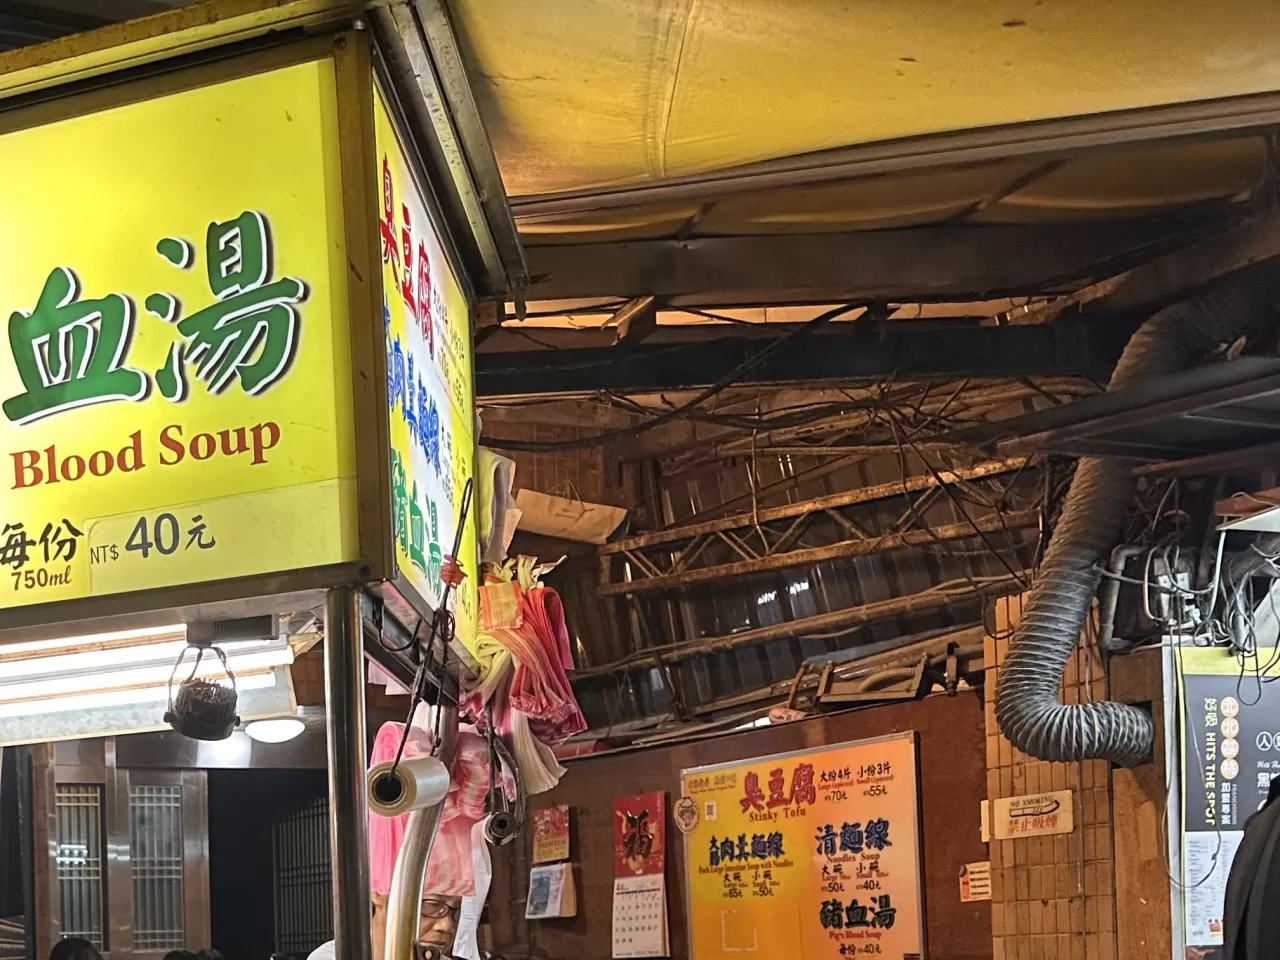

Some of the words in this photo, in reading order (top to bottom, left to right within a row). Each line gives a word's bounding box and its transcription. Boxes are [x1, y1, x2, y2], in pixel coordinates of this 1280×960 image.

[379, 152, 434, 360] 臭豆腐
[9, 430, 146, 490] Blood
[158, 419, 281, 467] Soup
[391, 448, 443, 600] 豬血湯
[1206, 732, 1216, 760] HITS
[739, 763, 816, 813] 臭豆腐
[1206, 764, 1216, 788] THE
[749, 810, 778, 822] Stinky
[783, 807, 806, 818] Tofu
[1010, 800, 1020, 808] NO
[1022, 795, 1054, 806] SMOKING
[814, 817, 892, 857] 清麵線
[820, 894, 897, 930] 豬血湯
